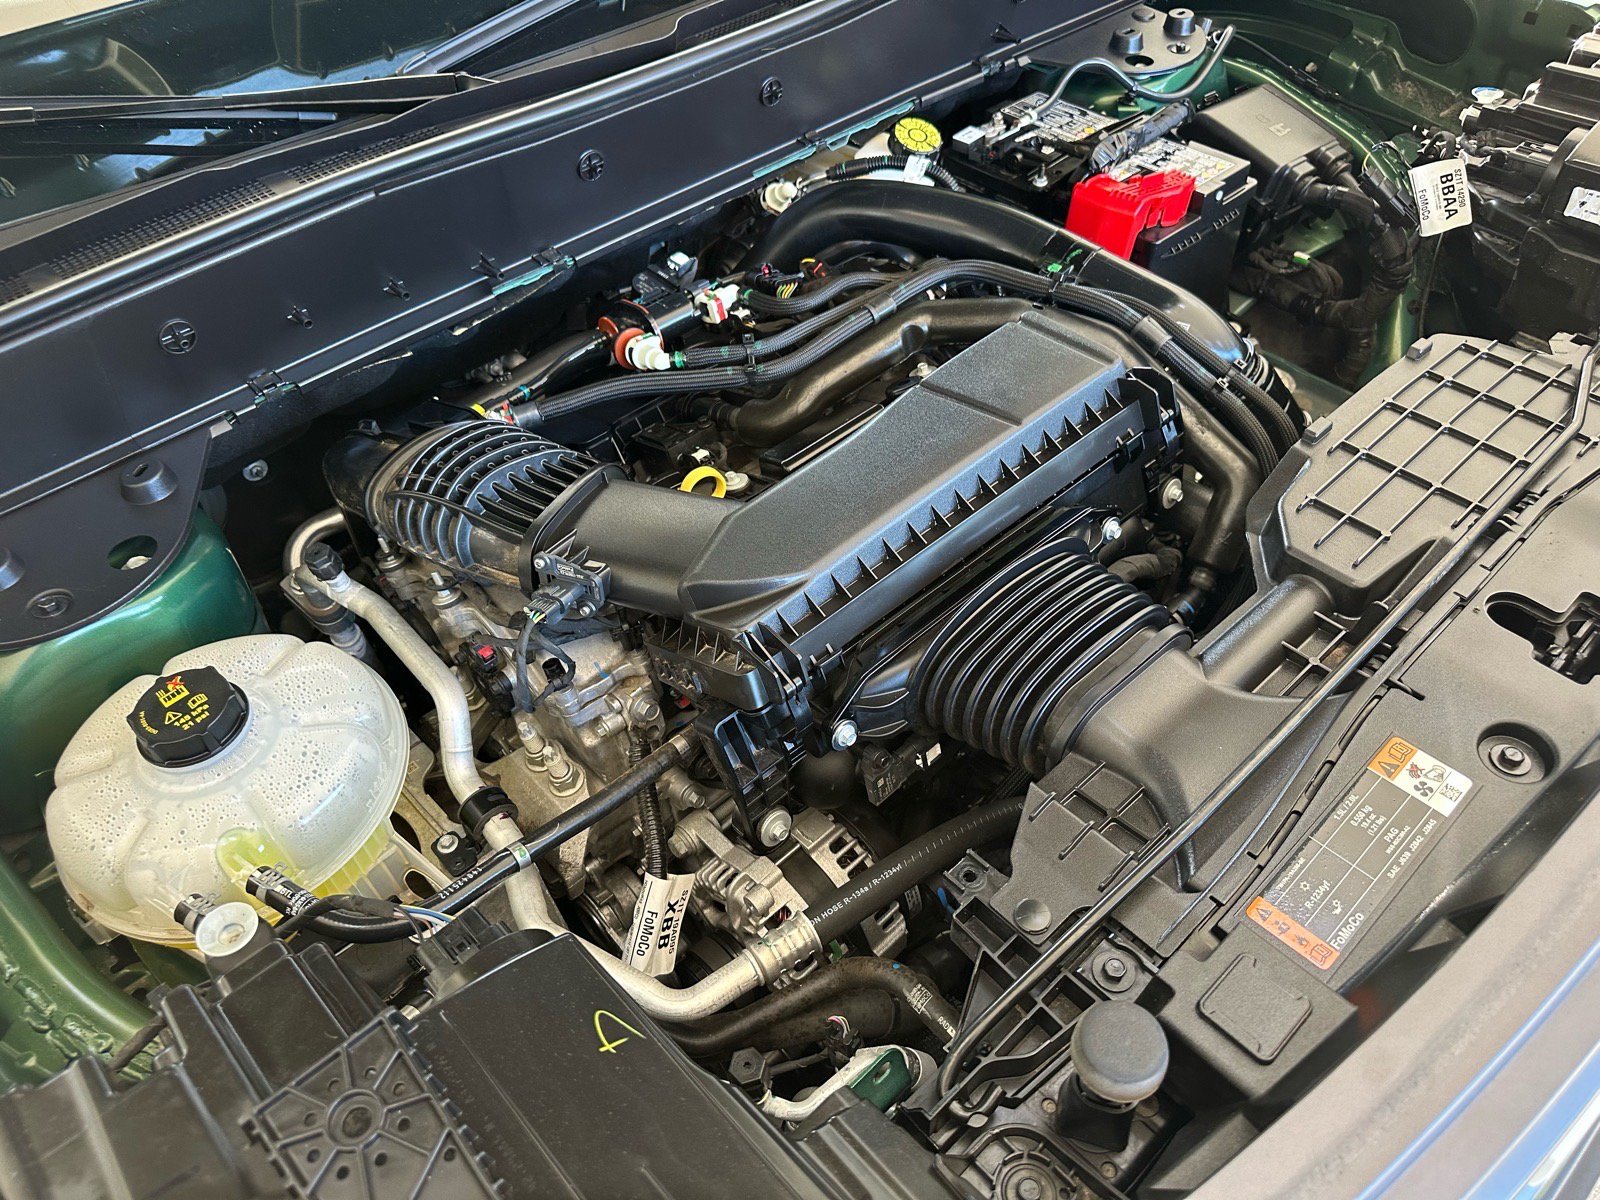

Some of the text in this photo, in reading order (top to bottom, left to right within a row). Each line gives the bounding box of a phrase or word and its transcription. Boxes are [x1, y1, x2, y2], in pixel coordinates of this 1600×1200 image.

[1418, 188, 1431, 221] FoMoCo
[1440, 172, 1459, 221] BBAA
[174, 714, 191, 726] 145
[182, 721, 194, 730] 21
[1363, 804, 1374, 814] kg
[1383, 827, 1399, 843] PAG
[1386, 863, 1401, 879] SAE
[820, 901, 844, 920] HOSE
[842, 885, 869, 905] R-134a
[872, 863, 903, 886] R-1234yf
[1304, 880, 1331, 909] R-1234yf
[636, 910, 658, 956] FoMoCo
[658, 900, 679, 949] XBB
[1329, 912, 1365, 950] FoMoCo
